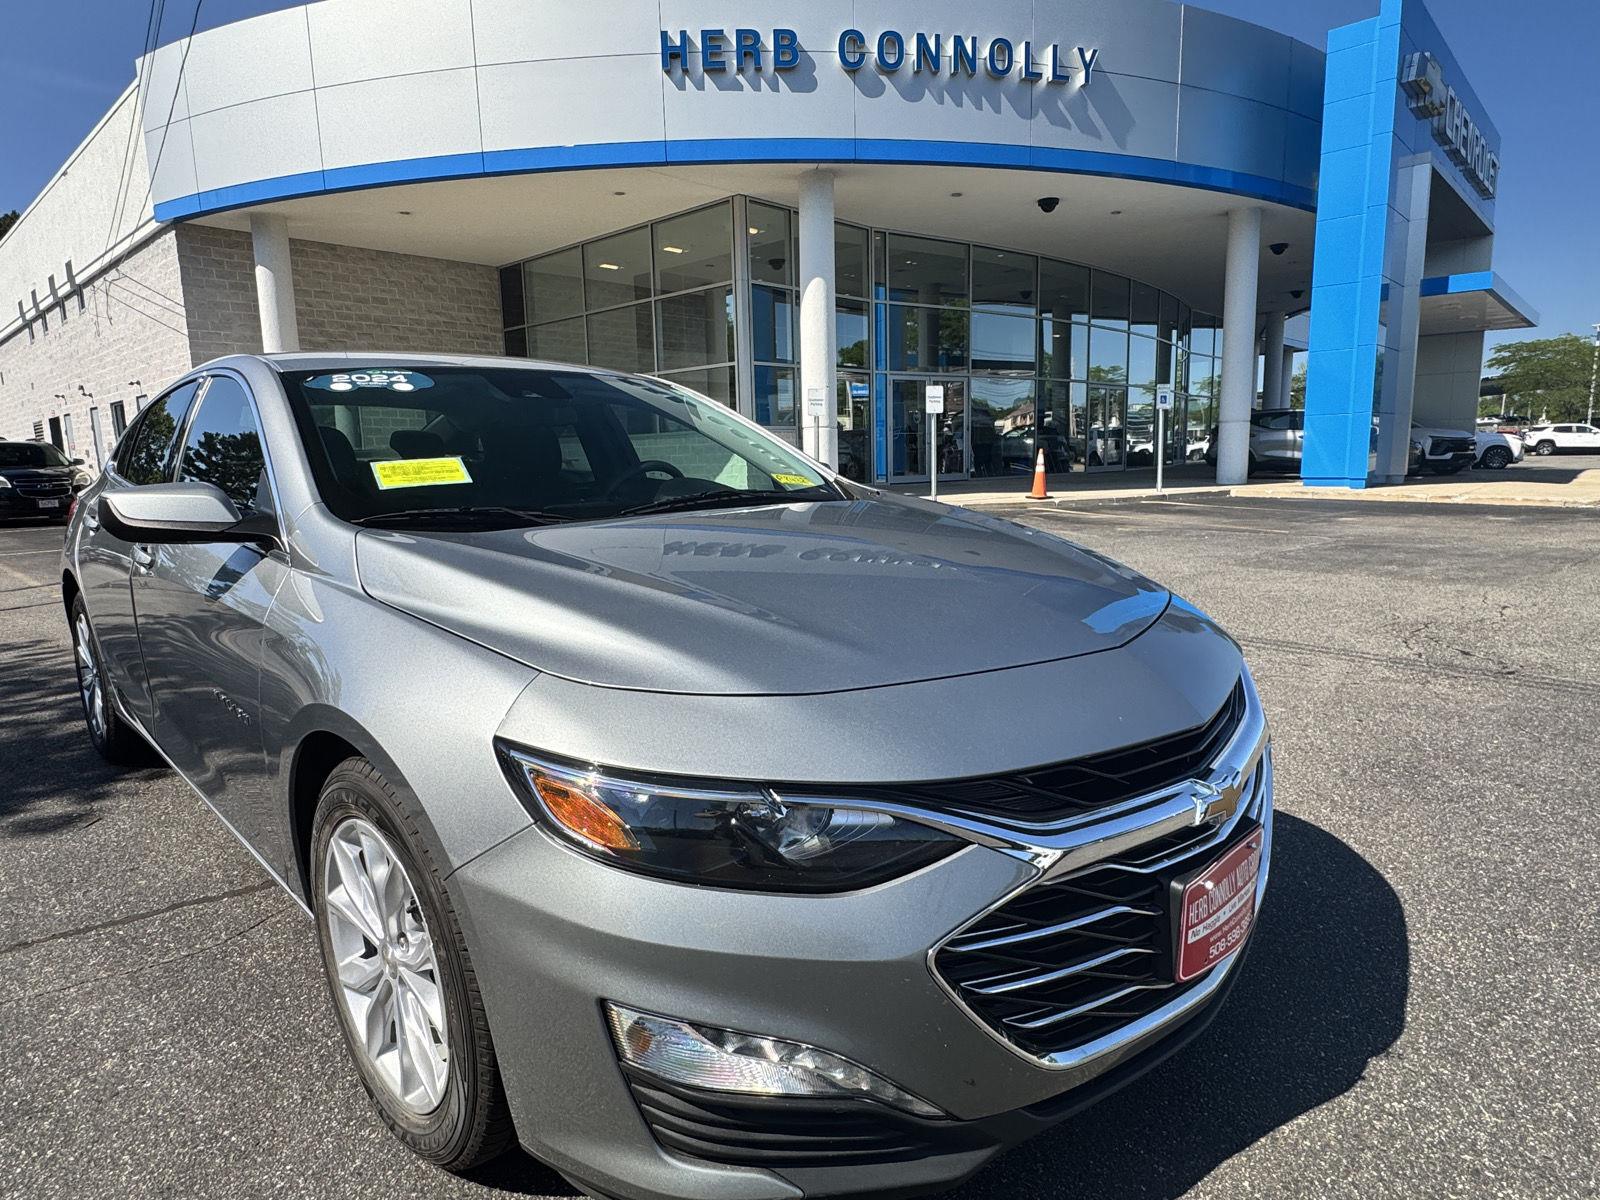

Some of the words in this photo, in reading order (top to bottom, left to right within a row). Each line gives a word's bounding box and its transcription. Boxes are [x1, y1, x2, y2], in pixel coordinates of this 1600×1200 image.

[660, 28, 800, 71] HERB
[837, 28, 1099, 87] CONNOLLY
[332, 374, 408, 383] 2024
[1188, 894, 1208, 927] HERB
[1190, 926, 1201, 941] No
